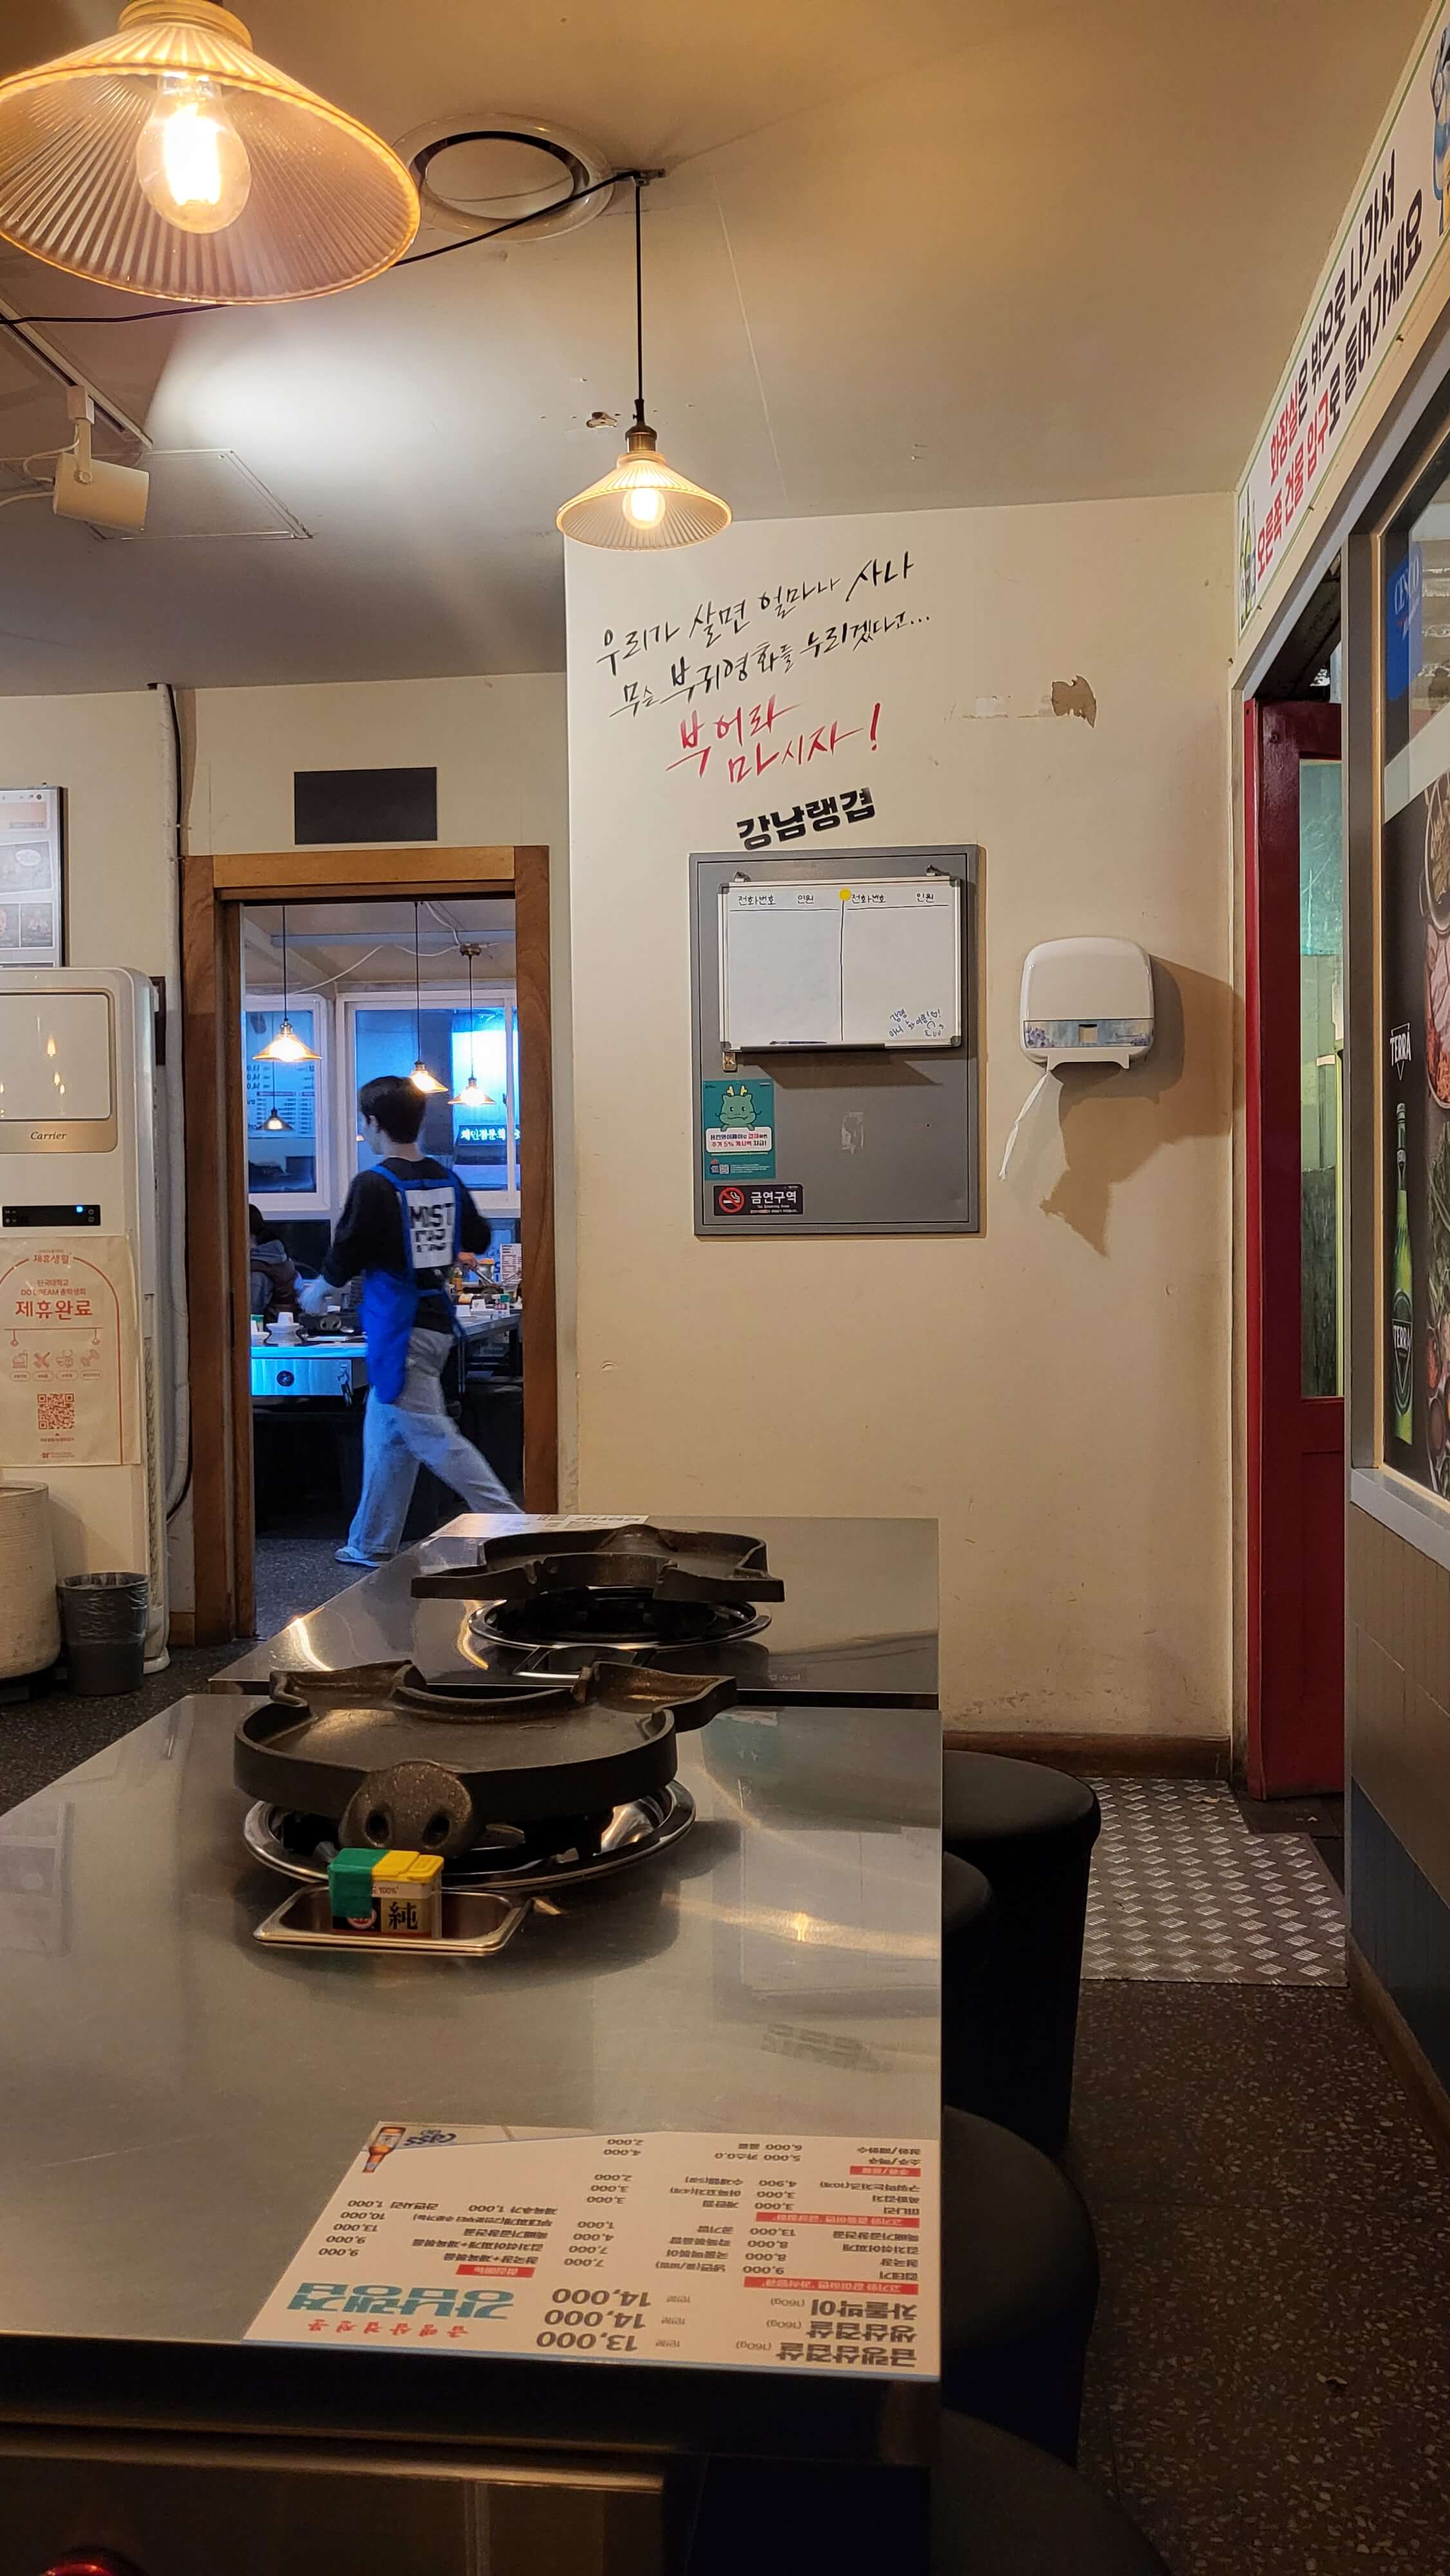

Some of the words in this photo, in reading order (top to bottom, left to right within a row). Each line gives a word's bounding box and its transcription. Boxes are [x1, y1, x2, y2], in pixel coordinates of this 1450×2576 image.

[1270, 358, 1308, 487] 화장실은
[1311, 267, 1346, 396] 밖으로
[1350, 148, 1395, 305] 나가서
[1285, 439, 1304, 528] 건물
[1308, 363, 1341, 482] 입구로
[1344, 189, 1422, 406] 들어가세요
[596, 623, 680, 676] 우리가
[689, 598, 749, 647] 살면
[760, 577, 841, 620] 얼마나
[845, 551, 914, 602] 사나
[666, 694, 802, 777] 부어라
[736, 787, 876, 851] 강남랭겹
[738, 895, 777, 905] 전화번호
[796, 894, 814, 904] 인원
[851, 893, 886, 904] 전화번호
[916, 893, 934, 902] 인원
[1389, 1030, 1411, 1066] TERRA
[30, 1131, 66, 1142] Carrier
[750, 1191, 796, 1204] 금연구역
[15, 1300, 93, 1320] 제휴완료
[1393, 1323, 1411, 1350] TERRA
[389, 1901, 419, 1930] 純
[469, 2204, 504, 2213] 1,000
[340, 2211, 386, 2220] 10,000
[334, 2223, 378, 2233] 13,000
[326, 2235, 366, 2244] 9,000
[573, 2233, 614, 2241] 4,000
[318, 2247, 360, 2257] 9,000
[569, 2246, 608, 2254] 7,000
[564, 2258, 605, 2267] 7,000
[746, 2253, 787, 2261] 8,000
[743, 2266, 785, 2274] 9,000
[287, 2283, 514, 2320] 강남랭겹
[552, 2289, 651, 2307] 14,000
[770, 2298, 805, 2307] (160g)
[811, 2299, 917, 2320] 차돌박이
[544, 2309, 645, 2329] 14,000
[767, 2320, 802, 2329] (160g)
[806, 2321, 917, 2343] 생삼겹살
[536, 2332, 638, 2351] 13,000
[736, 2341, 772, 2351] (160g)
[777, 2342, 916, 2368] 급랭삼겹살
